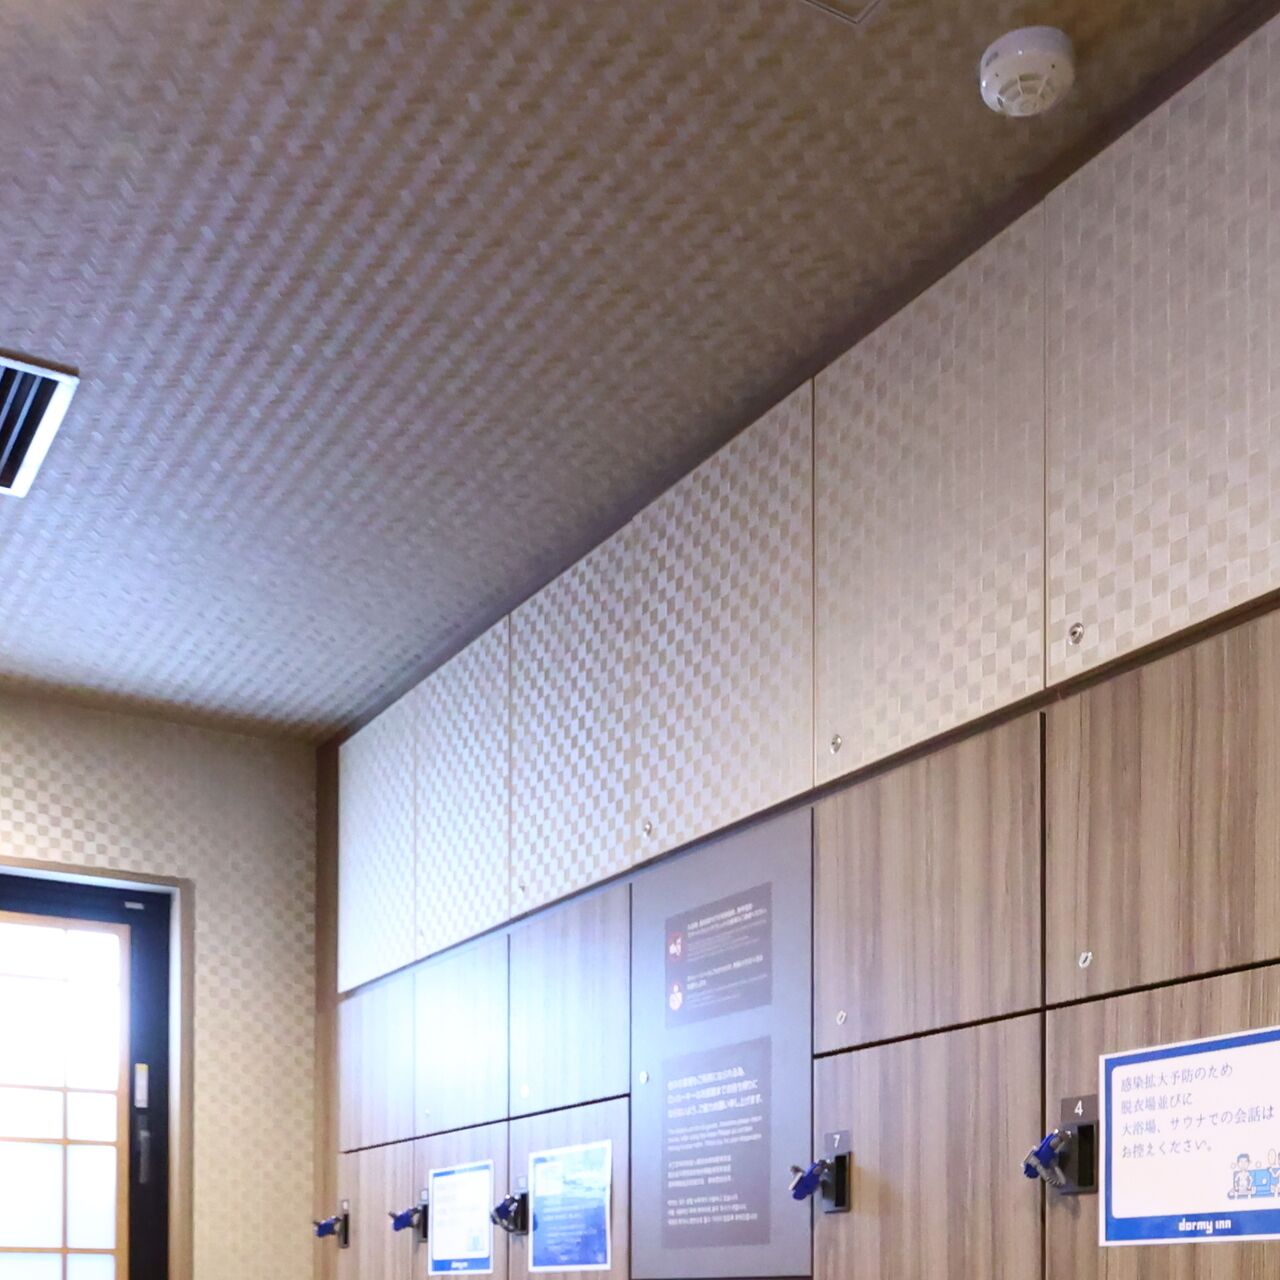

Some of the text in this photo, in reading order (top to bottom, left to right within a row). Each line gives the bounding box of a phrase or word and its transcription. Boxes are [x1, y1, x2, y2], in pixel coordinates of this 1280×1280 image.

[1074, 1100, 1083, 1116] 4
[833, 1133, 841, 1148] 7
[1122, 1139, 1211, 1158] お控えください。
[1178, 1218, 1231, 1234] dormy inn
